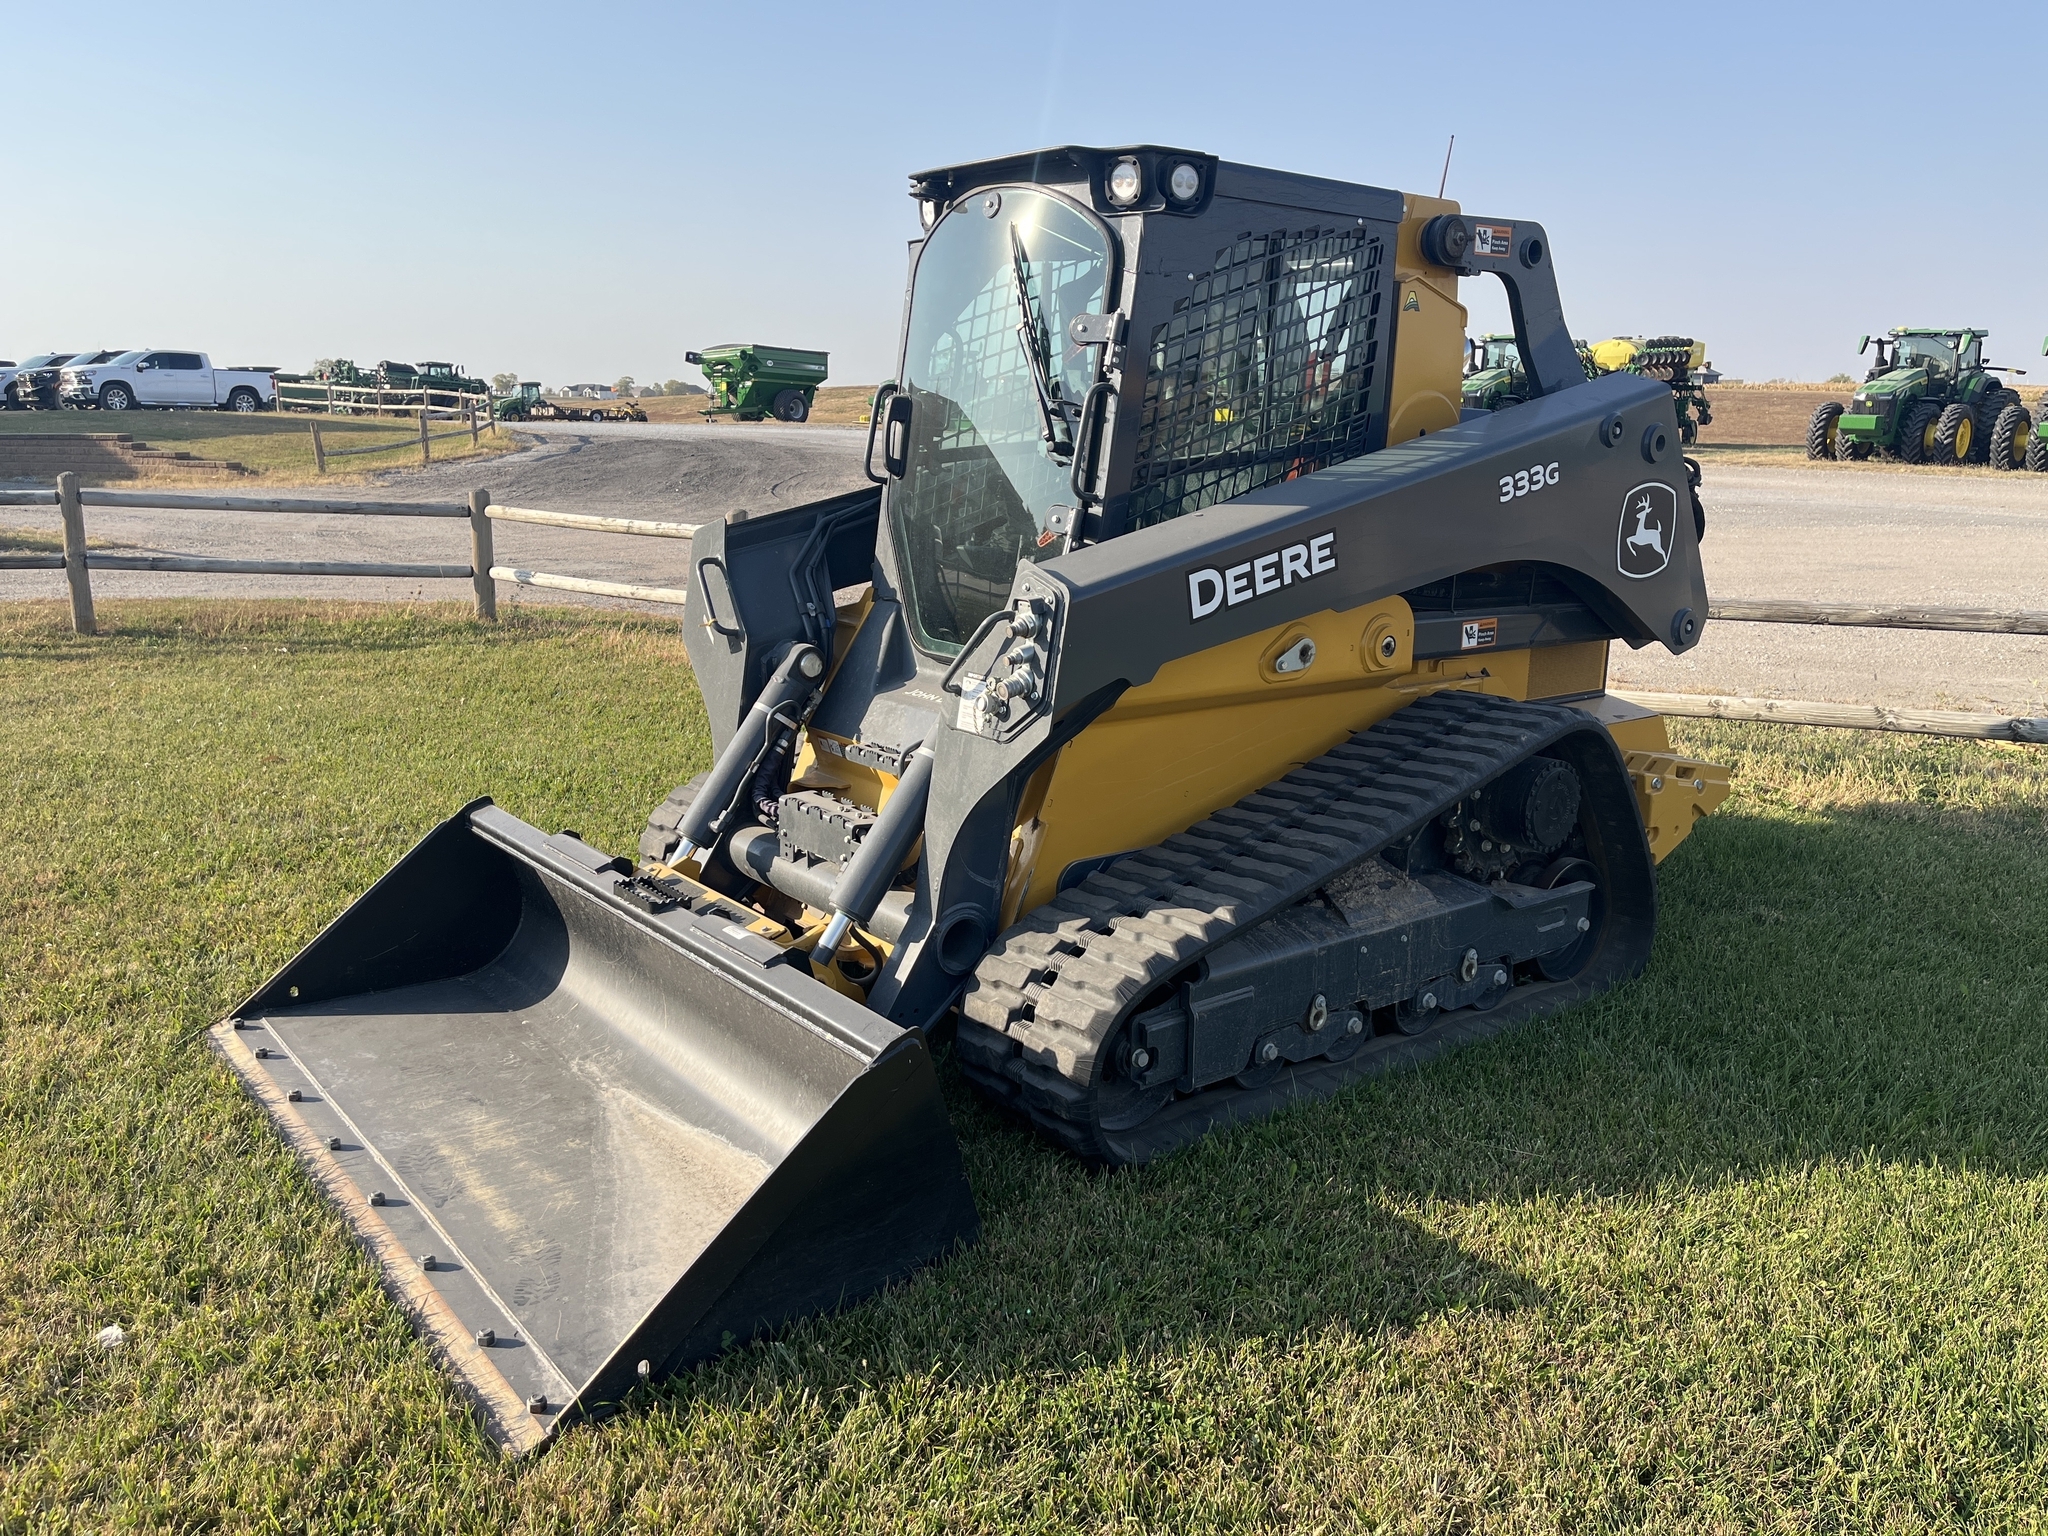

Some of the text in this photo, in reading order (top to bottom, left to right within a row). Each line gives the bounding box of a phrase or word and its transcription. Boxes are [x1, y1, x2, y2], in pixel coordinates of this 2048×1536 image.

[1499, 462, 1560, 503] 333G
[1188, 532, 1336, 620] DEERE
[904, 689, 940, 701] JOHN
